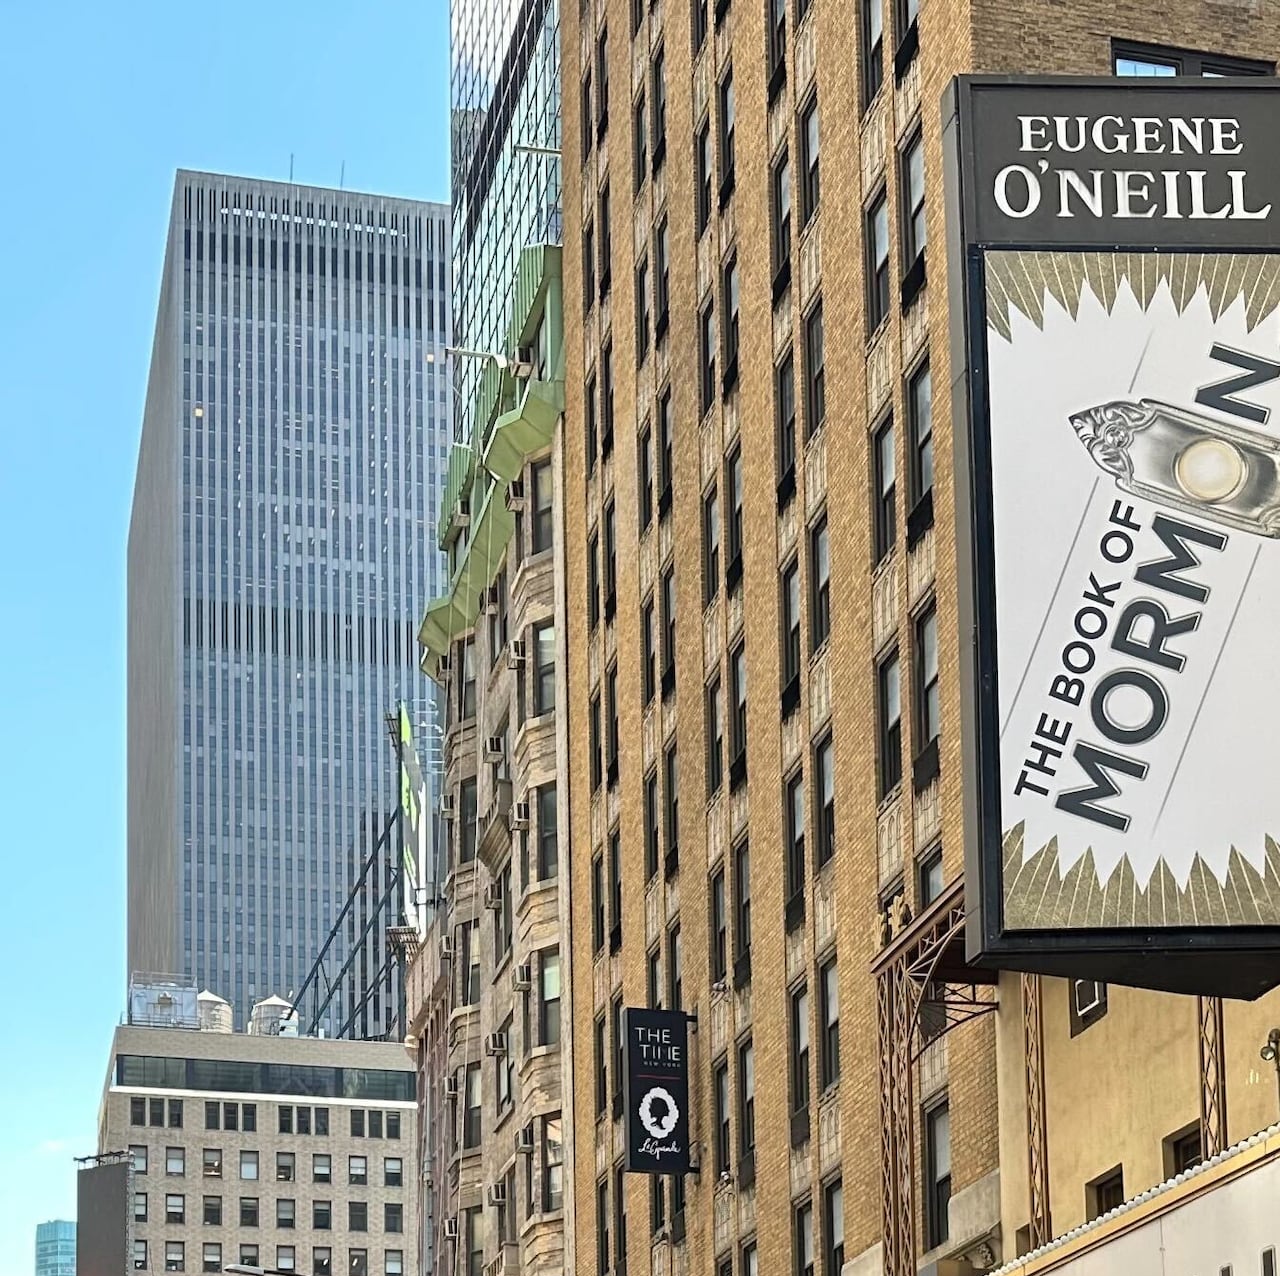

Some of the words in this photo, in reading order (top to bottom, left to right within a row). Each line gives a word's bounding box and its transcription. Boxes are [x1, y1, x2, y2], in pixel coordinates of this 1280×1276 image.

[1017, 114, 1244, 155] EUGENE
[992, 158, 1273, 221] O’NEILL
[1014, 712, 1072, 797] THE
[1048, 571, 1122, 708] BOOK
[1099, 499, 1142, 564] OF
[635, 1027, 670, 1044] THE
